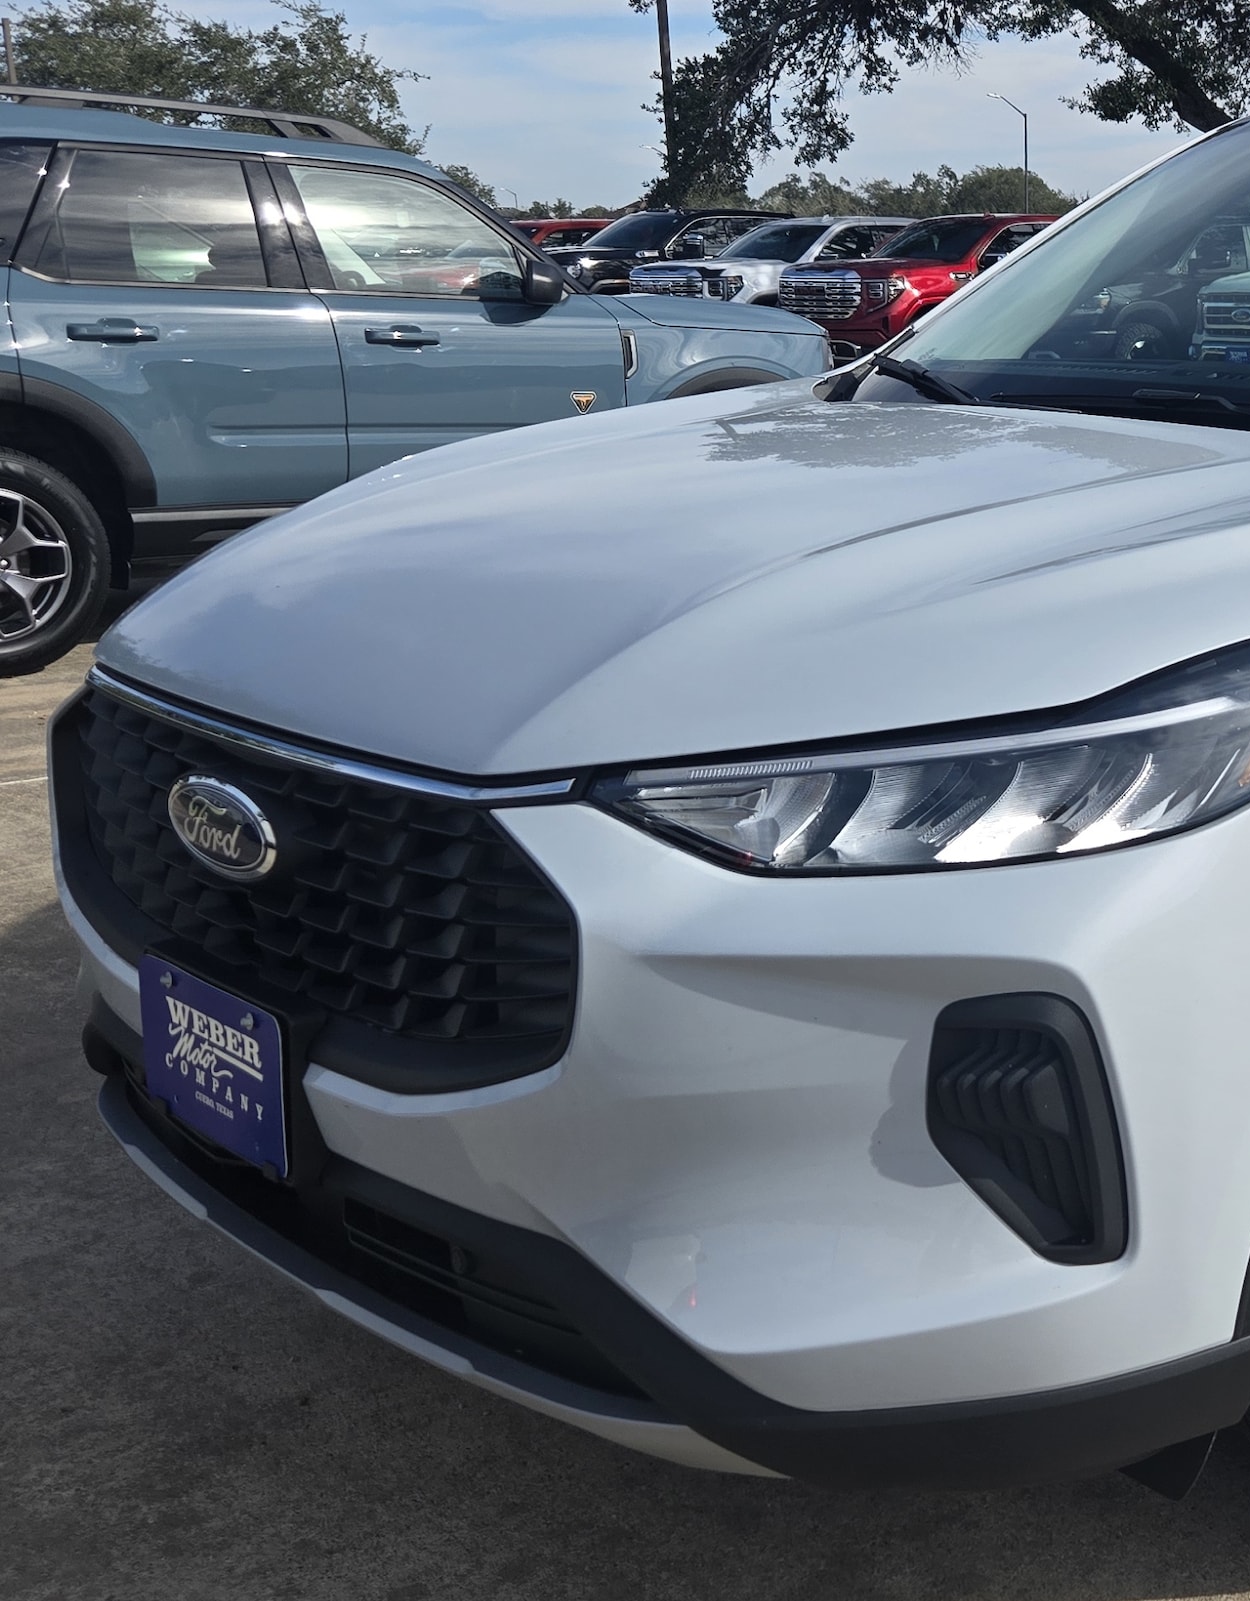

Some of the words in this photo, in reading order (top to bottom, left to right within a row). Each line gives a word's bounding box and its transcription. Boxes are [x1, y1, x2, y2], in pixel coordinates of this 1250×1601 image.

[184, 795, 242, 860] Ford
[165, 995, 263, 1069] WEBER
[168, 1022, 234, 1078] Motor
[165, 1052, 263, 1121] COMPANY
